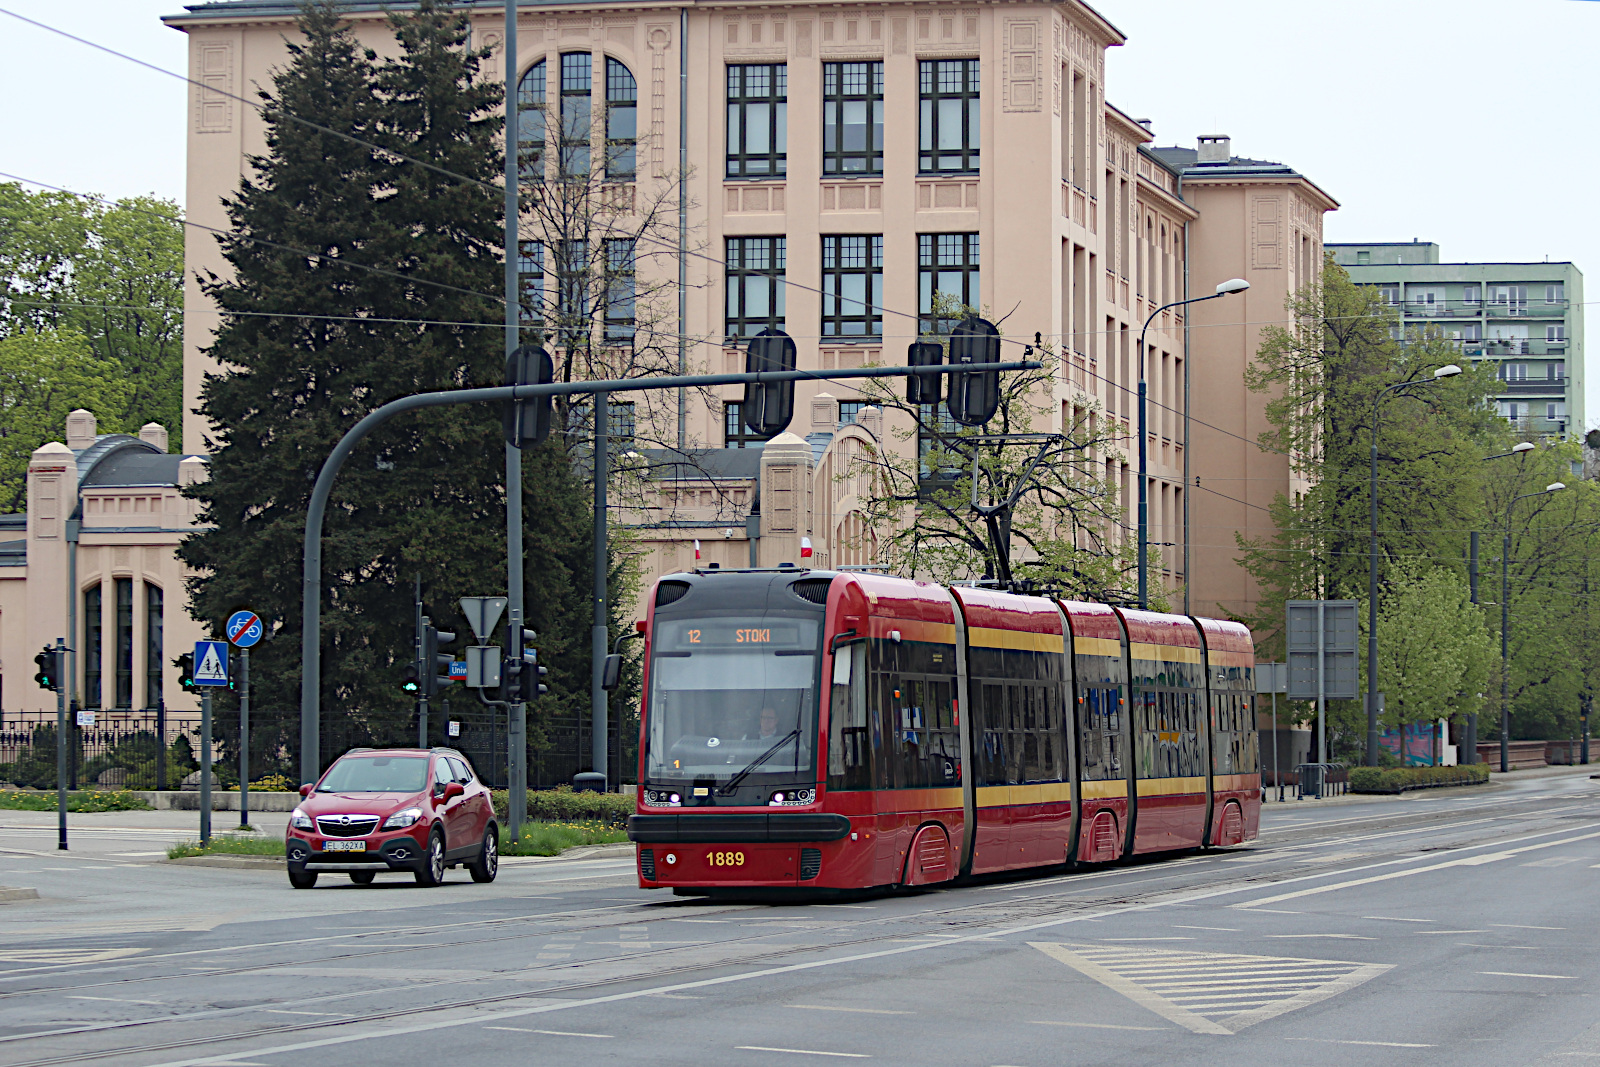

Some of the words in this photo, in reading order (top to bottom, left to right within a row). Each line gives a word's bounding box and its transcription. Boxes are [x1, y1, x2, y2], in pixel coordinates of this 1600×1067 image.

[688, 629, 701, 643] 12
[736, 629, 770, 643] STOKI
[673, 759, 680, 769] 1
[327, 841, 338, 850] EL
[341, 841, 364, 850] 362XA
[706, 851, 745, 866] 1889
